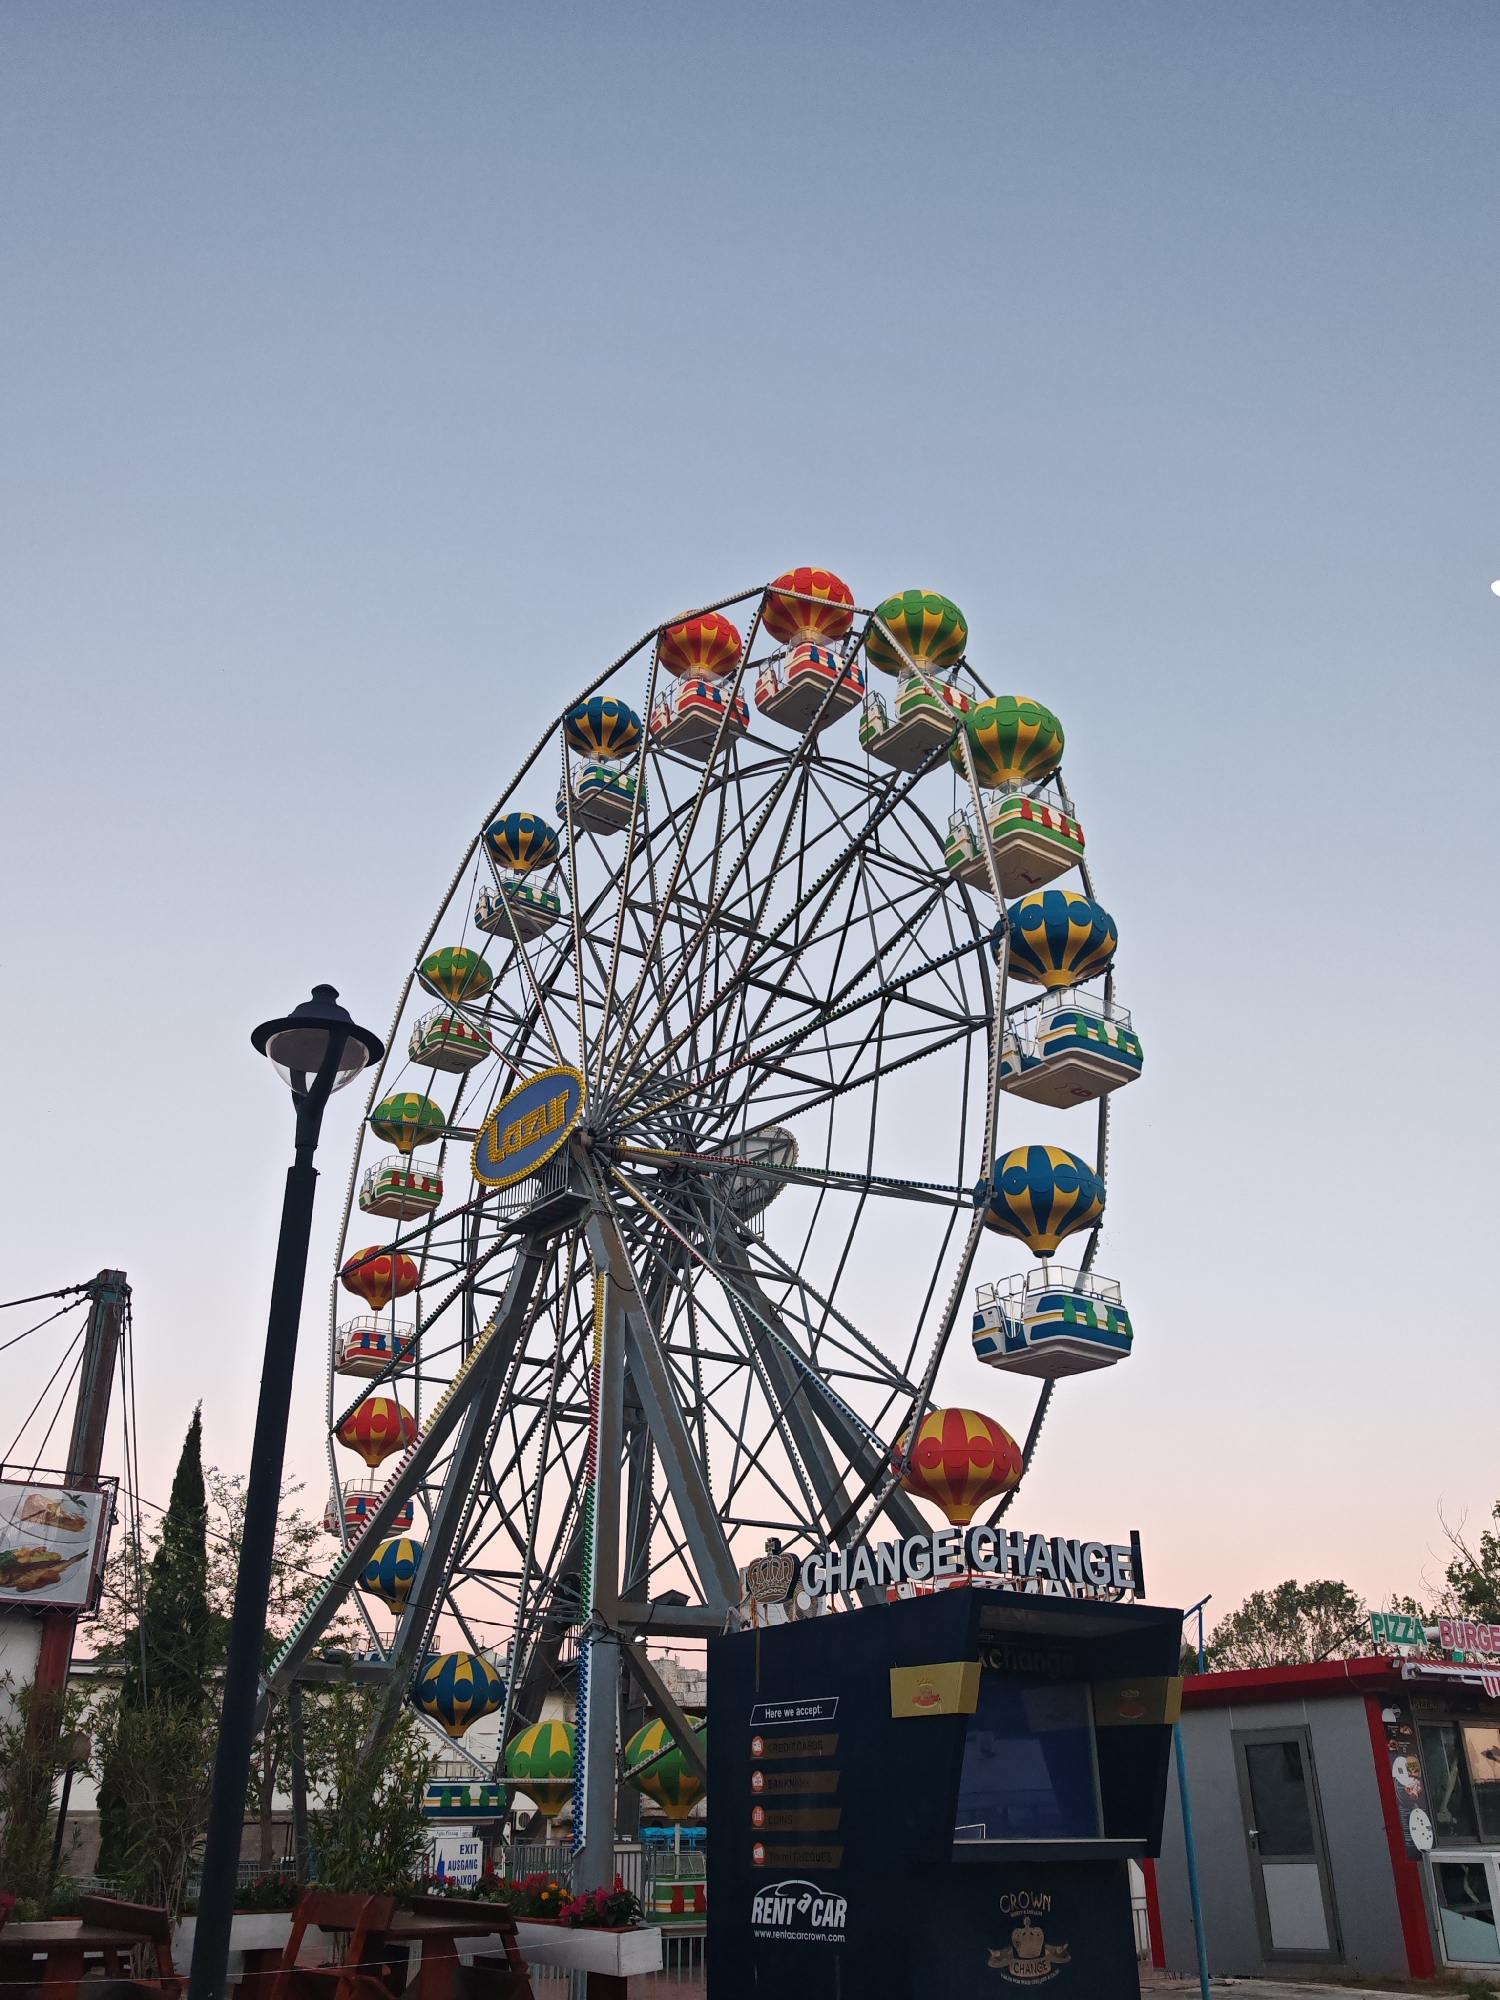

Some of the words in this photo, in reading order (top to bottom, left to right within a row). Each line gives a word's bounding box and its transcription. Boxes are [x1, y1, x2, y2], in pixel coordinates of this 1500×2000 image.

[488, 1089, 570, 1164] Lazur
[802, 1528, 965, 1598] CHANGE
[966, 1525, 1138, 1594] CHANGE
[1370, 1612, 1429, 1646] PIZZA
[1438, 1618, 1500, 1655] BURGE
[765, 1707, 782, 1719] Here
[784, 1708, 795, 1717] we
[795, 1704, 823, 1717] accept:
[767, 1741, 795, 1753] CREDIT
[797, 1740, 823, 1752] CARDS
[768, 1815, 793, 1825] COINS
[459, 1843, 479, 1855] EXIT
[447, 1859, 478, 1871] AUSGANG
[999, 1890, 1052, 1913] CROWN
[751, 1896, 797, 1925] RENT
[810, 1898, 849, 1928] CAR
[753, 1929, 846, 1943] www.rentacarcrown.com
[1013, 1960, 1048, 1974] CHANGE
